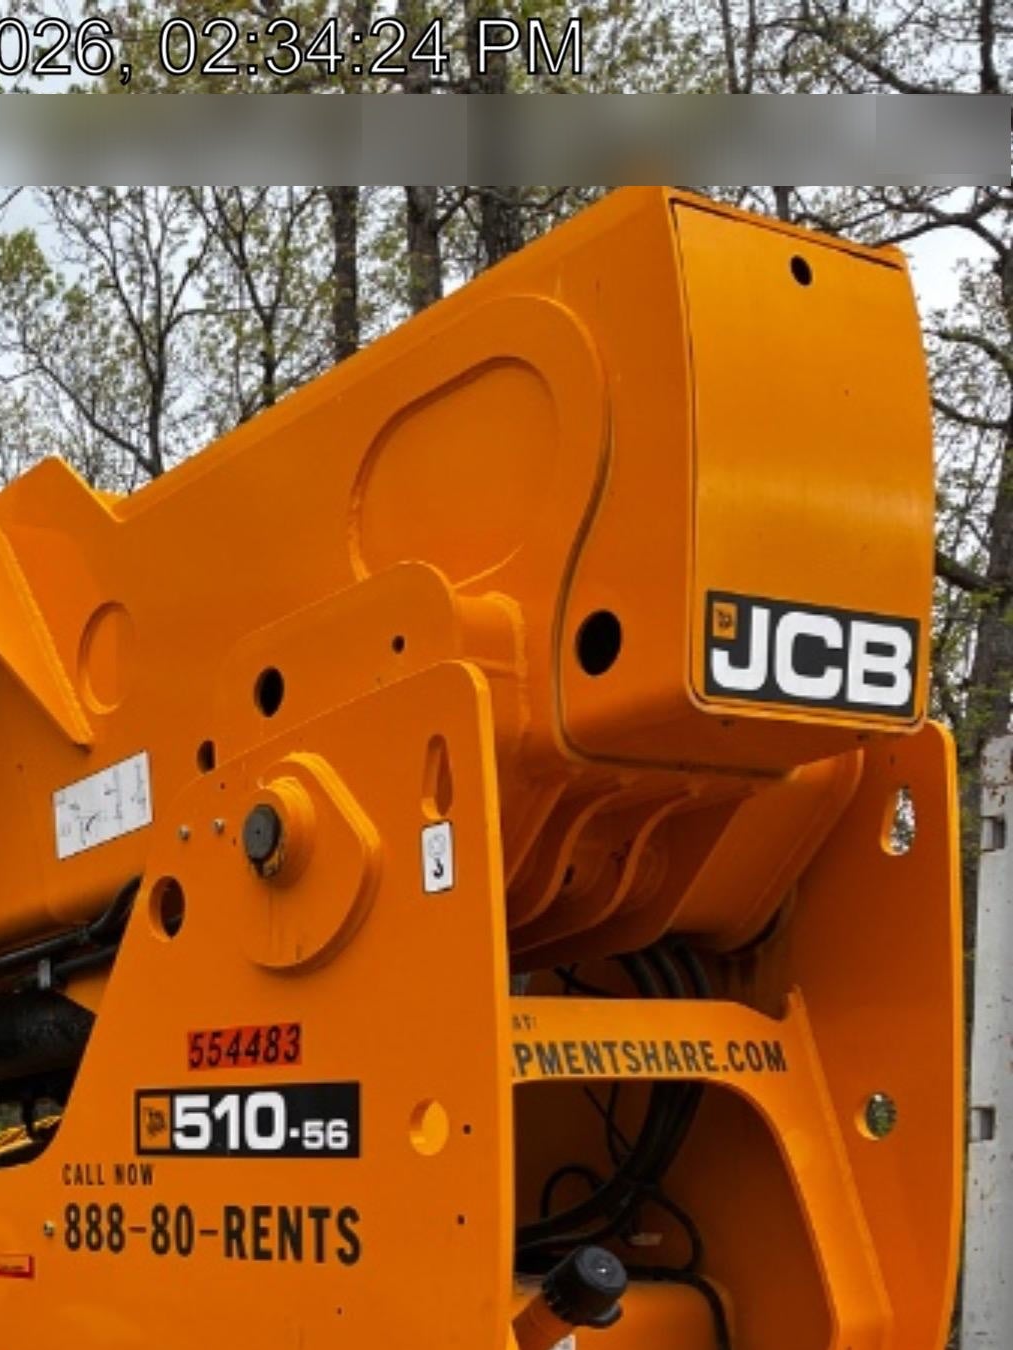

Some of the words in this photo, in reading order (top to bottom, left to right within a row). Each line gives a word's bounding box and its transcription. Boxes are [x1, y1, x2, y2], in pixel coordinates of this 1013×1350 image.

[711, 605, 913, 707] JCB
[189, 1024, 302, 1069] 554483
[511, 1040, 786, 1077] PMENTSHARE.COM
[62, 1163, 105, 1186] CALL
[115, 1162, 154, 1186] NOW
[64, 1203, 361, 1266] 888-80-RENTS
